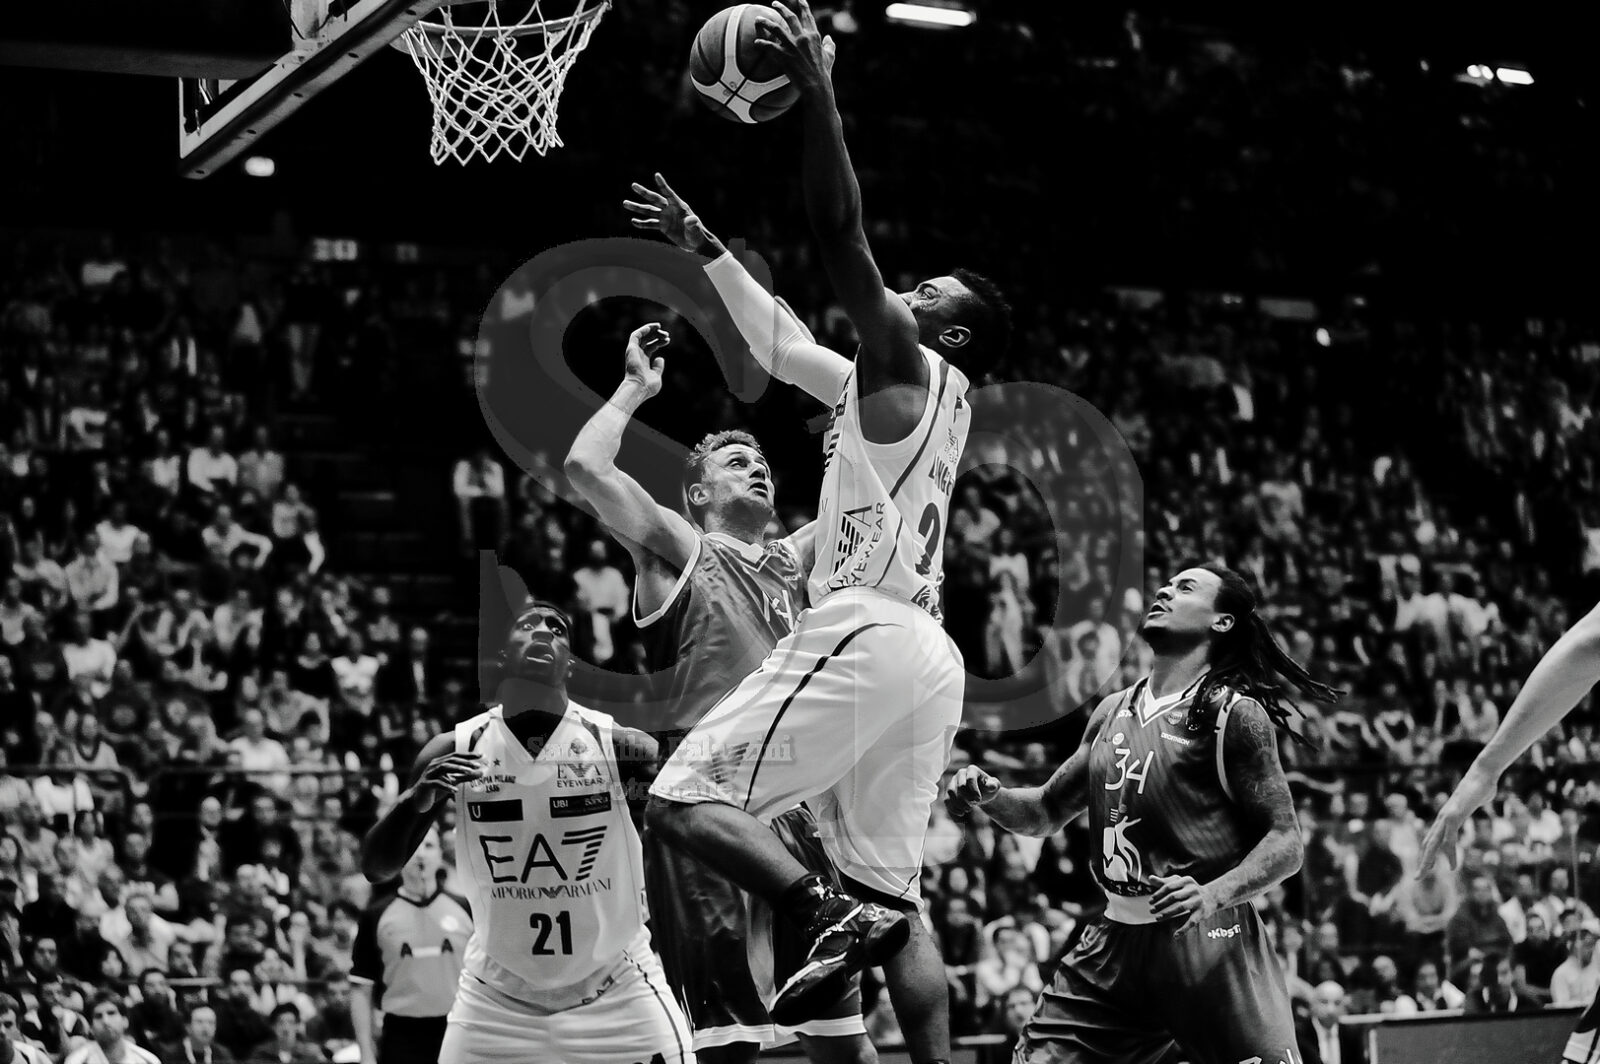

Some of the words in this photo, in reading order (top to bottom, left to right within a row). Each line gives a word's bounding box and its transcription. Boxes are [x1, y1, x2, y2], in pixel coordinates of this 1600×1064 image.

[557, 777, 604, 789] EYEWEAR
[1105, 748, 1155, 795] 34
[552, 799, 569, 809] UBI
[479, 825, 608, 885] EA7
[529, 910, 573, 956] 21
